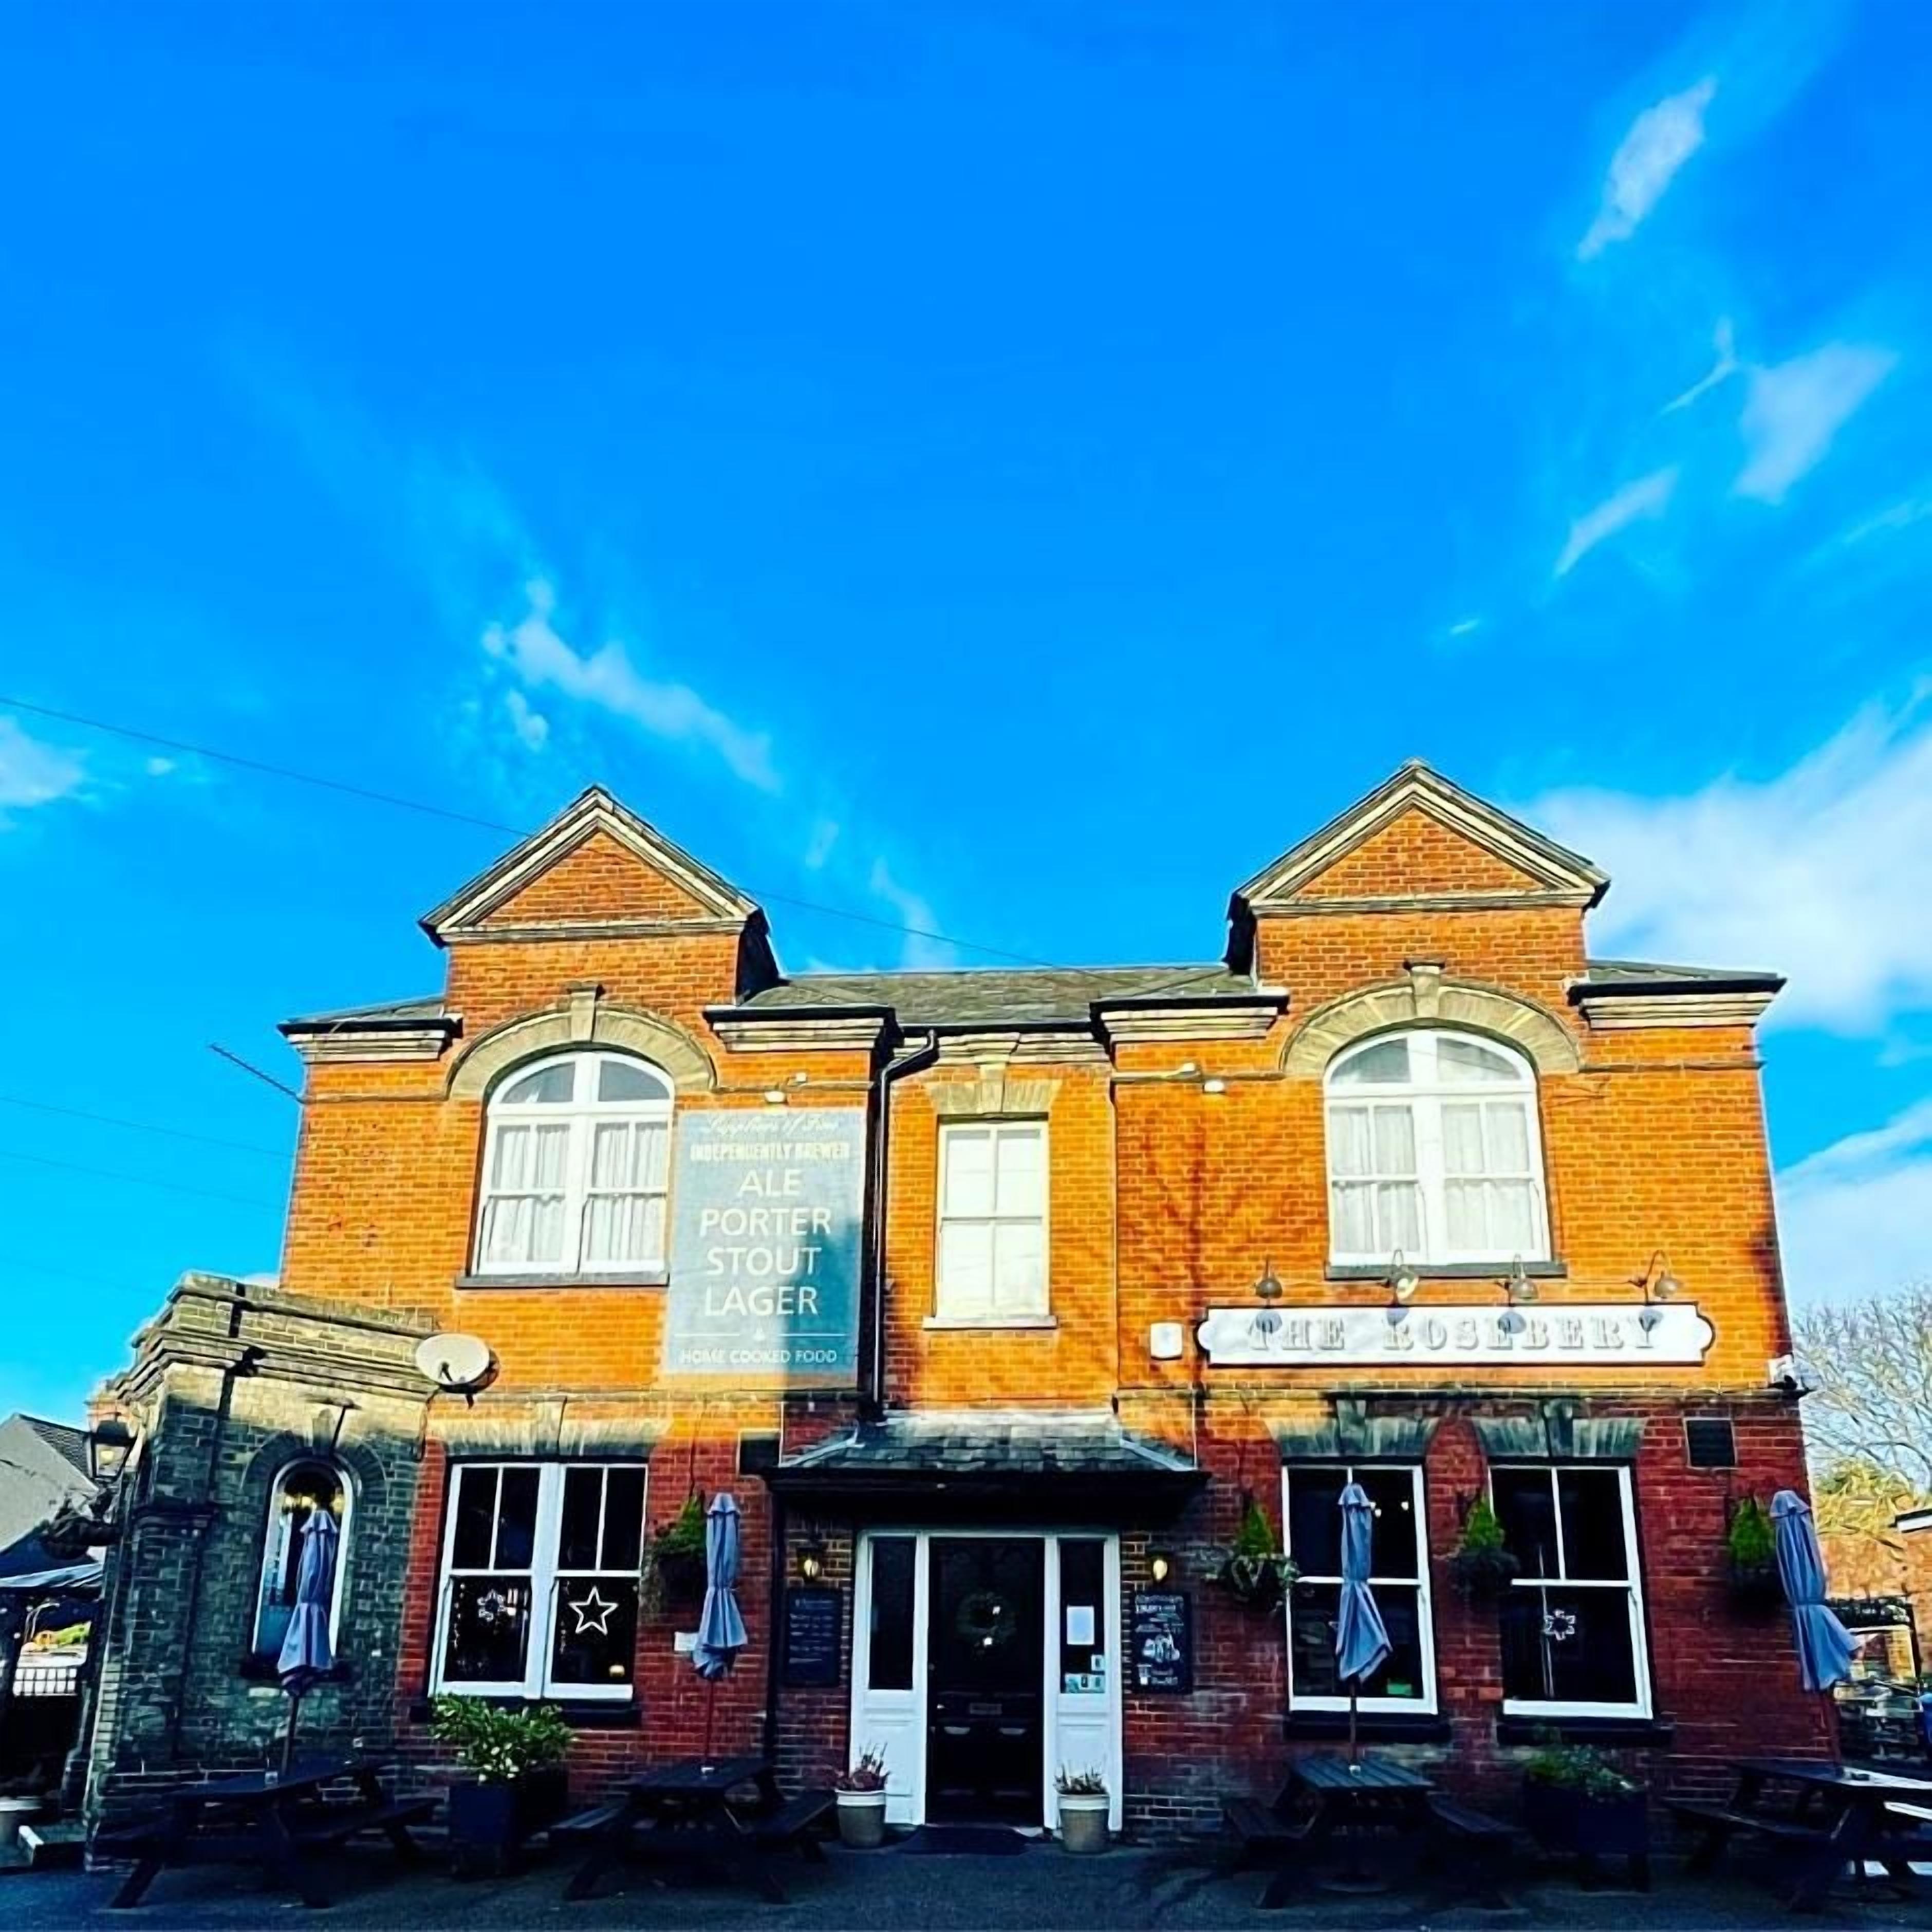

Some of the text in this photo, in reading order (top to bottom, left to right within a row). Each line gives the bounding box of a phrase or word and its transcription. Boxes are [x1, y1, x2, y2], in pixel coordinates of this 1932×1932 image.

[738, 1169, 802, 1197] ALE
[700, 1208, 831, 1236] PORTER
[707, 1247, 822, 1275] STOUT
[704, 1287, 819, 1316] LAGER
[1247, 1316, 1659, 1351] THE ROSEBERY
[682, 1349, 837, 1363] HOME COOKED FOOD
